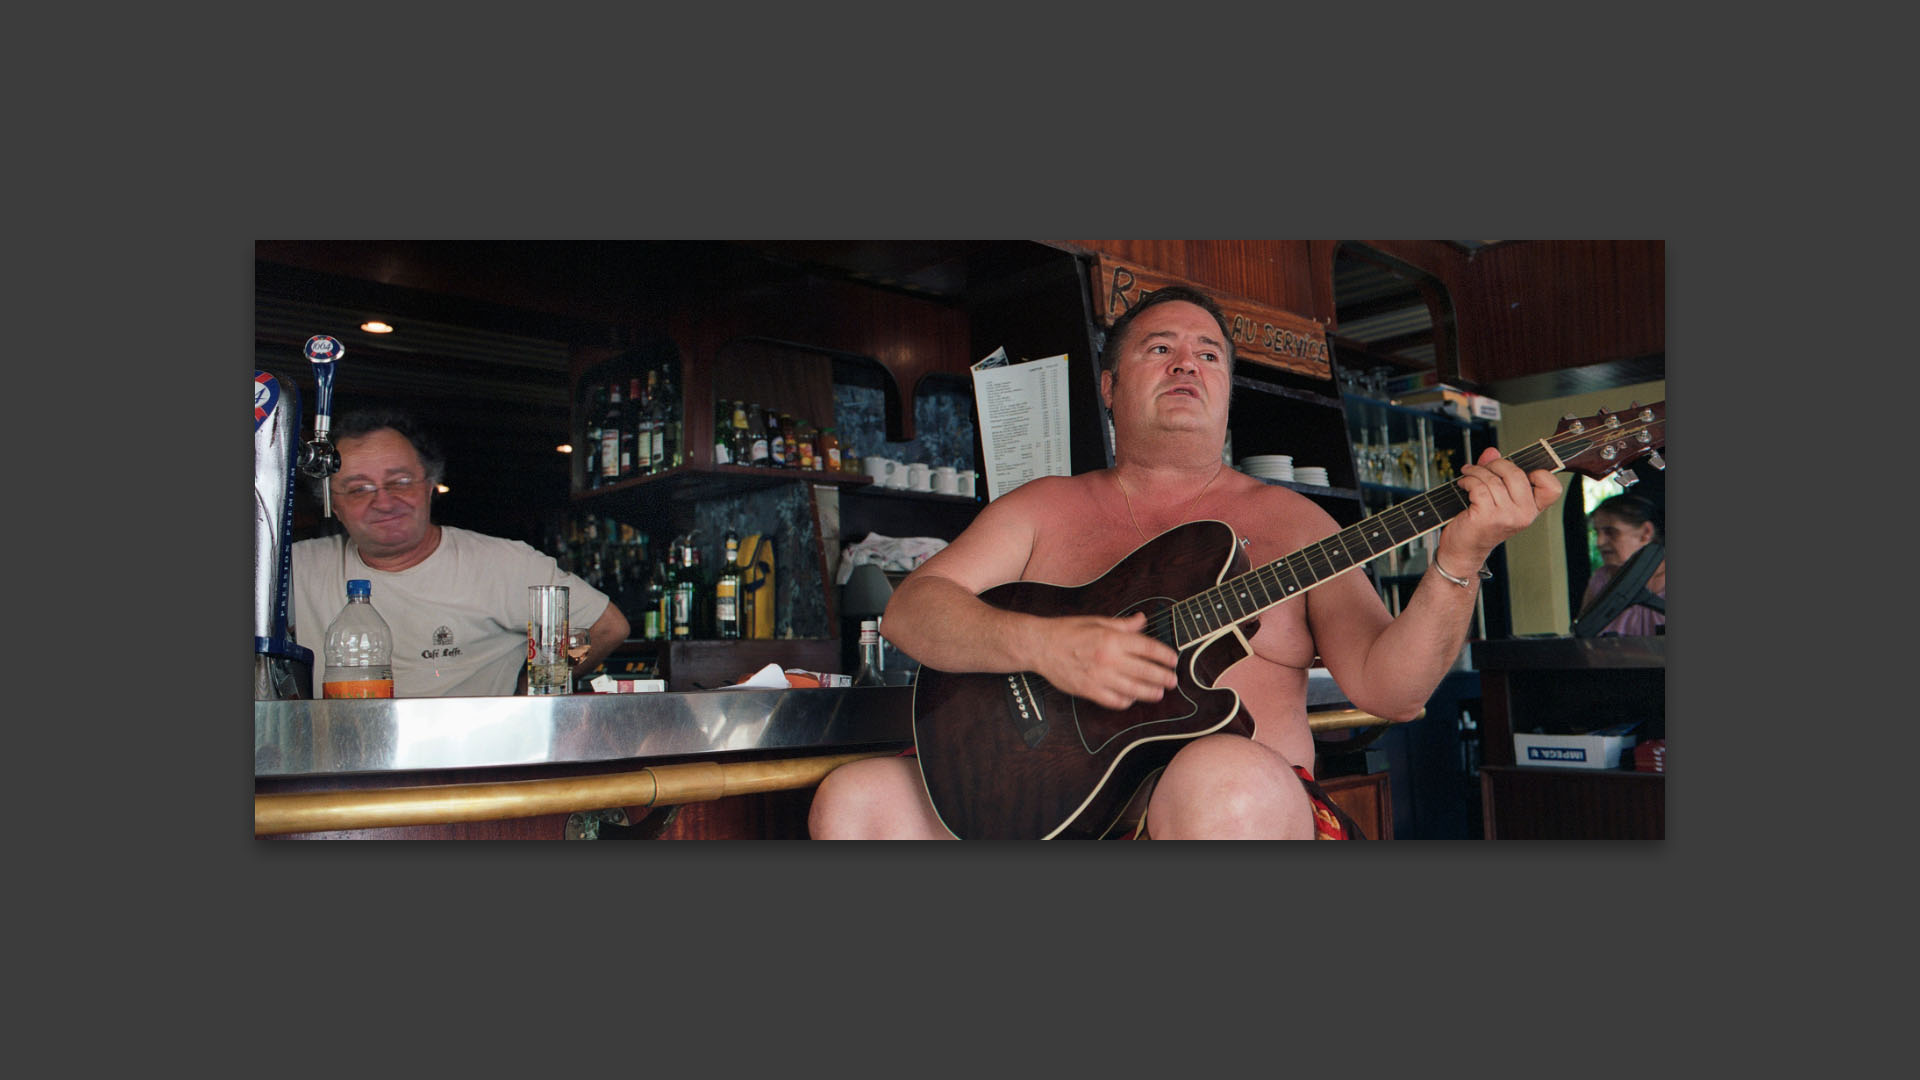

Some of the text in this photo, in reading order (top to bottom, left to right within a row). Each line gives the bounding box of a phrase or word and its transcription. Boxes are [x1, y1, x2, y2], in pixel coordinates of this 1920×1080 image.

[1232, 313, 1258, 343] AU
[1263, 323, 1328, 364] SERVICE
[280, 467, 296, 617] PRESSION PREMIUM
